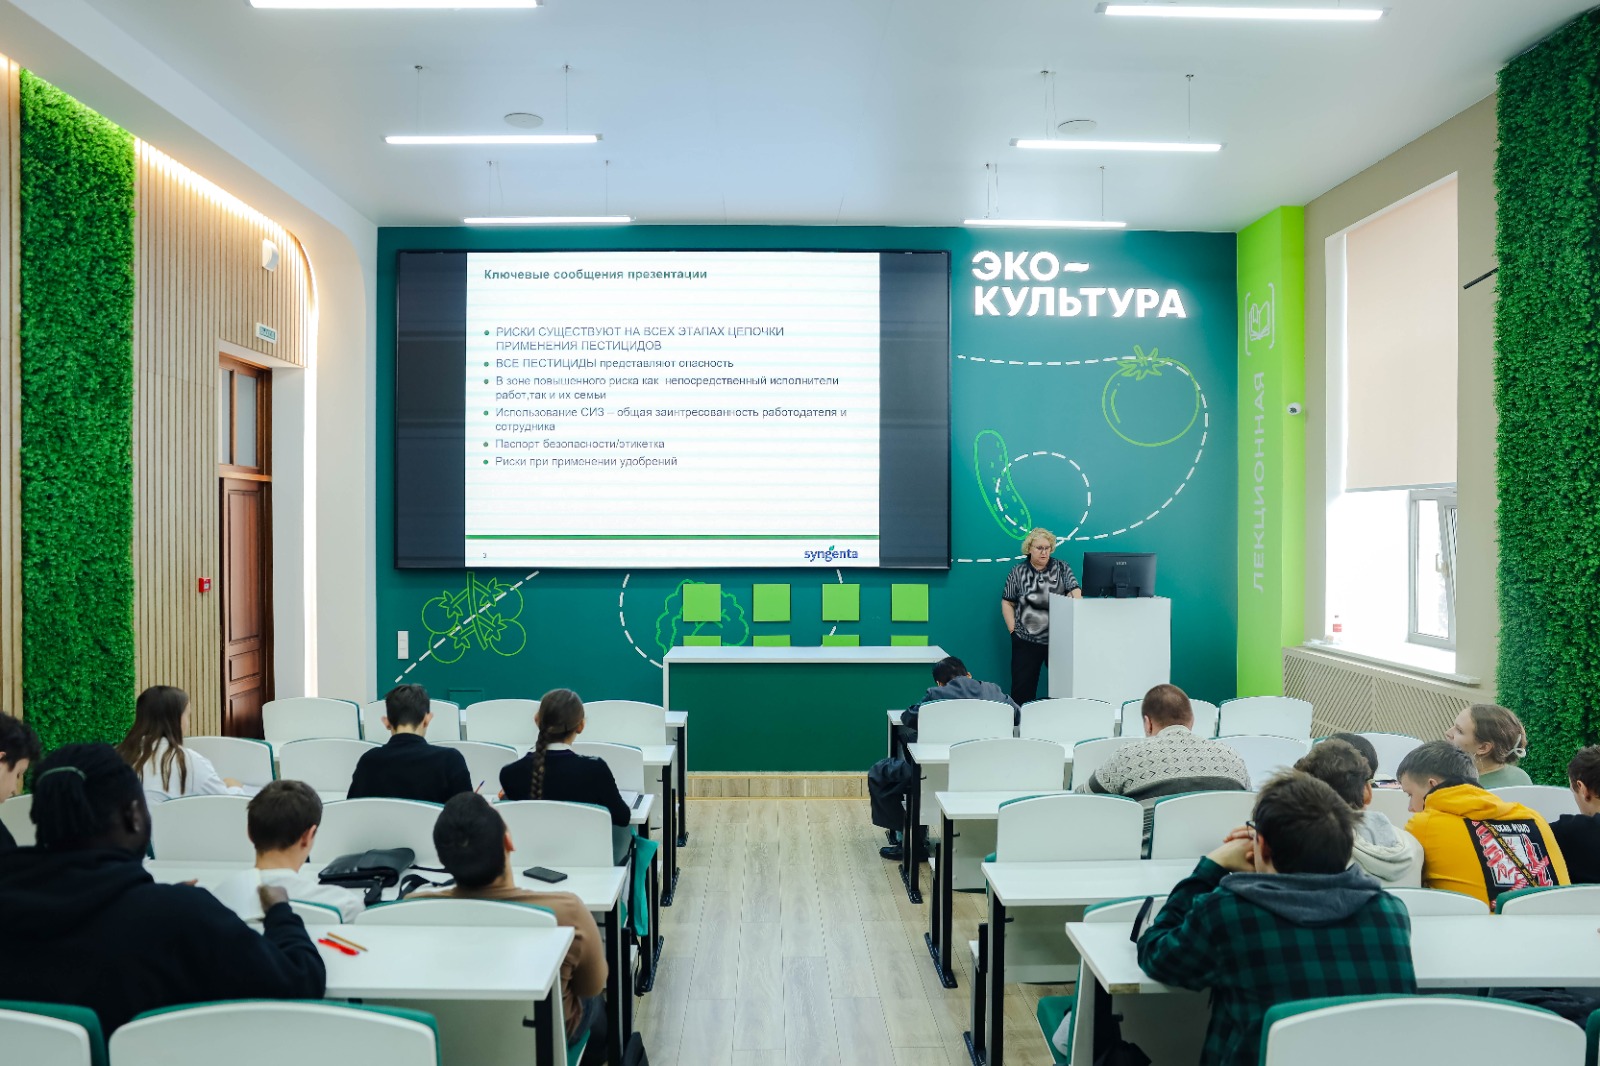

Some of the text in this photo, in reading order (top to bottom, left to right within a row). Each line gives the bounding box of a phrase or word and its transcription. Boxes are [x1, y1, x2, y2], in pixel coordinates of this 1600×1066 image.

[484, 269, 708, 282] Ключевые сообщения презентации
[974, 286, 1188, 319] КУЛЬТУРА
[496, 327, 785, 338] РИСКИ СУЩЕСТВУЮТ НА ВСЕХ ЭТАПАХ ЦЕПОЧКИ
[496, 341, 662, 352] ПРИМЕНЕНИЯ ПЕСТИЦИДОВ
[496, 359, 734, 370] ВСЕ ПЕСТИЦИДЫ представляют опасность
[496, 376, 504, 385] В
[533, 377, 606, 386] повышенного
[608, 378, 639, 388] риска
[642, 377, 658, 385] как
[665, 375, 767, 387] непосредственный
[769, 377, 839, 385] исполнители
[549, 392, 556, 400] и
[558, 392, 571, 400] их
[573, 392, 607, 400] семьи
[496, 407, 578, 418] Использование
[580, 407, 605, 417] СИЗ
[617, 407, 653, 419] общая
[655, 409, 759, 419] заинтресованность
[762, 407, 837, 420] работодателя
[840, 409, 847, 417] и
[495, 423, 556, 433] сотрудника
[495, 439, 665, 450] Паспорт безопасности/этикетка
[495, 456, 678, 468] Риски при применении удобрений
[1253, 371, 1267, 594] ЛЕКЦИОННАЯ
[804, 548, 859, 562] syngenta
